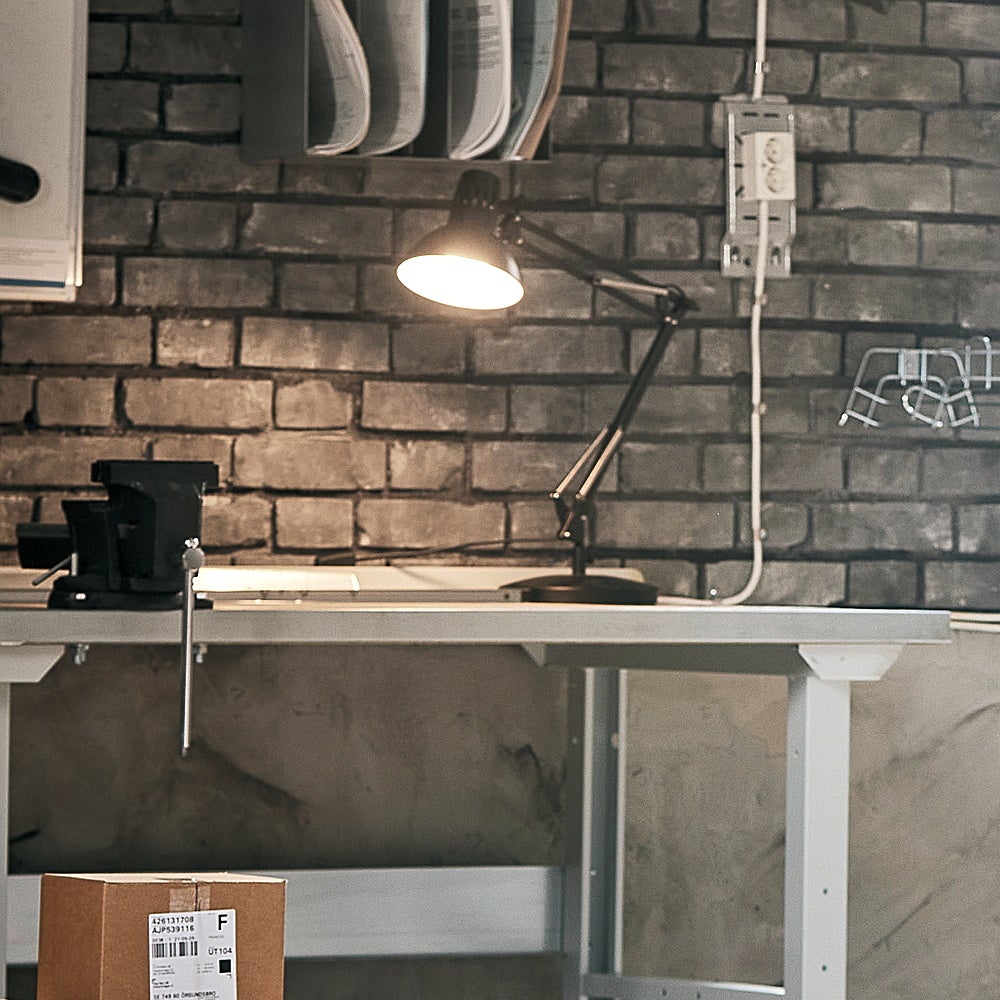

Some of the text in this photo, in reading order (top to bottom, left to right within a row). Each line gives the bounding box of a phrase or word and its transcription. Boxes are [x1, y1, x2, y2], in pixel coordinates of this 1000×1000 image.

[151, 916, 195, 925] 426131708
[217, 914, 228, 931] F
[151, 925, 195, 934] AJP539116
